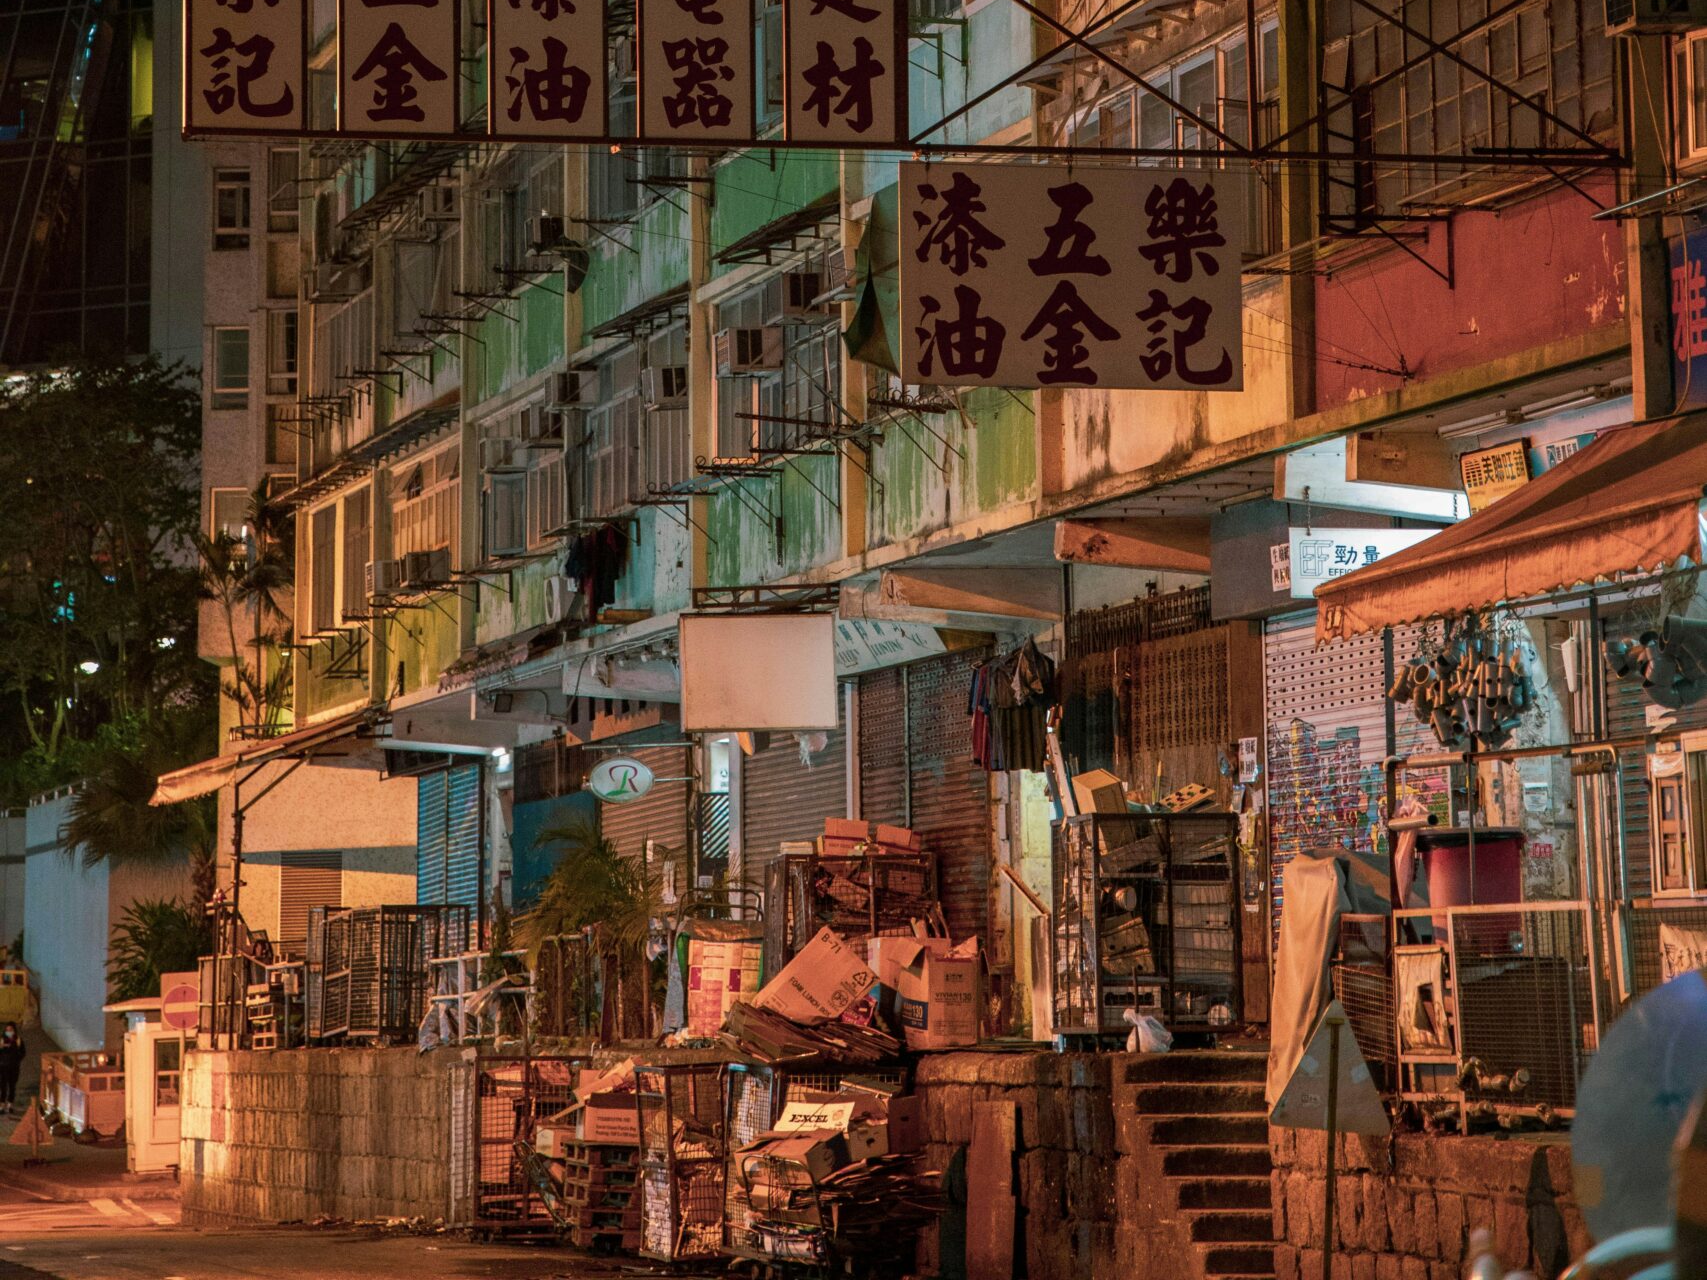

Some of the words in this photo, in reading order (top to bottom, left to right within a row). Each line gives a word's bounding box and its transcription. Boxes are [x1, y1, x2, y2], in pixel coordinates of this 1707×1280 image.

[913, 172, 1006, 379] 漆油
[1021, 181, 1122, 385] 五金
[1135, 177, 1234, 385] 樂記
[1334, 544, 1381, 567] 勁量
[820, 932, 842, 954] B-71
[789, 1114, 829, 1123] EXCEL
